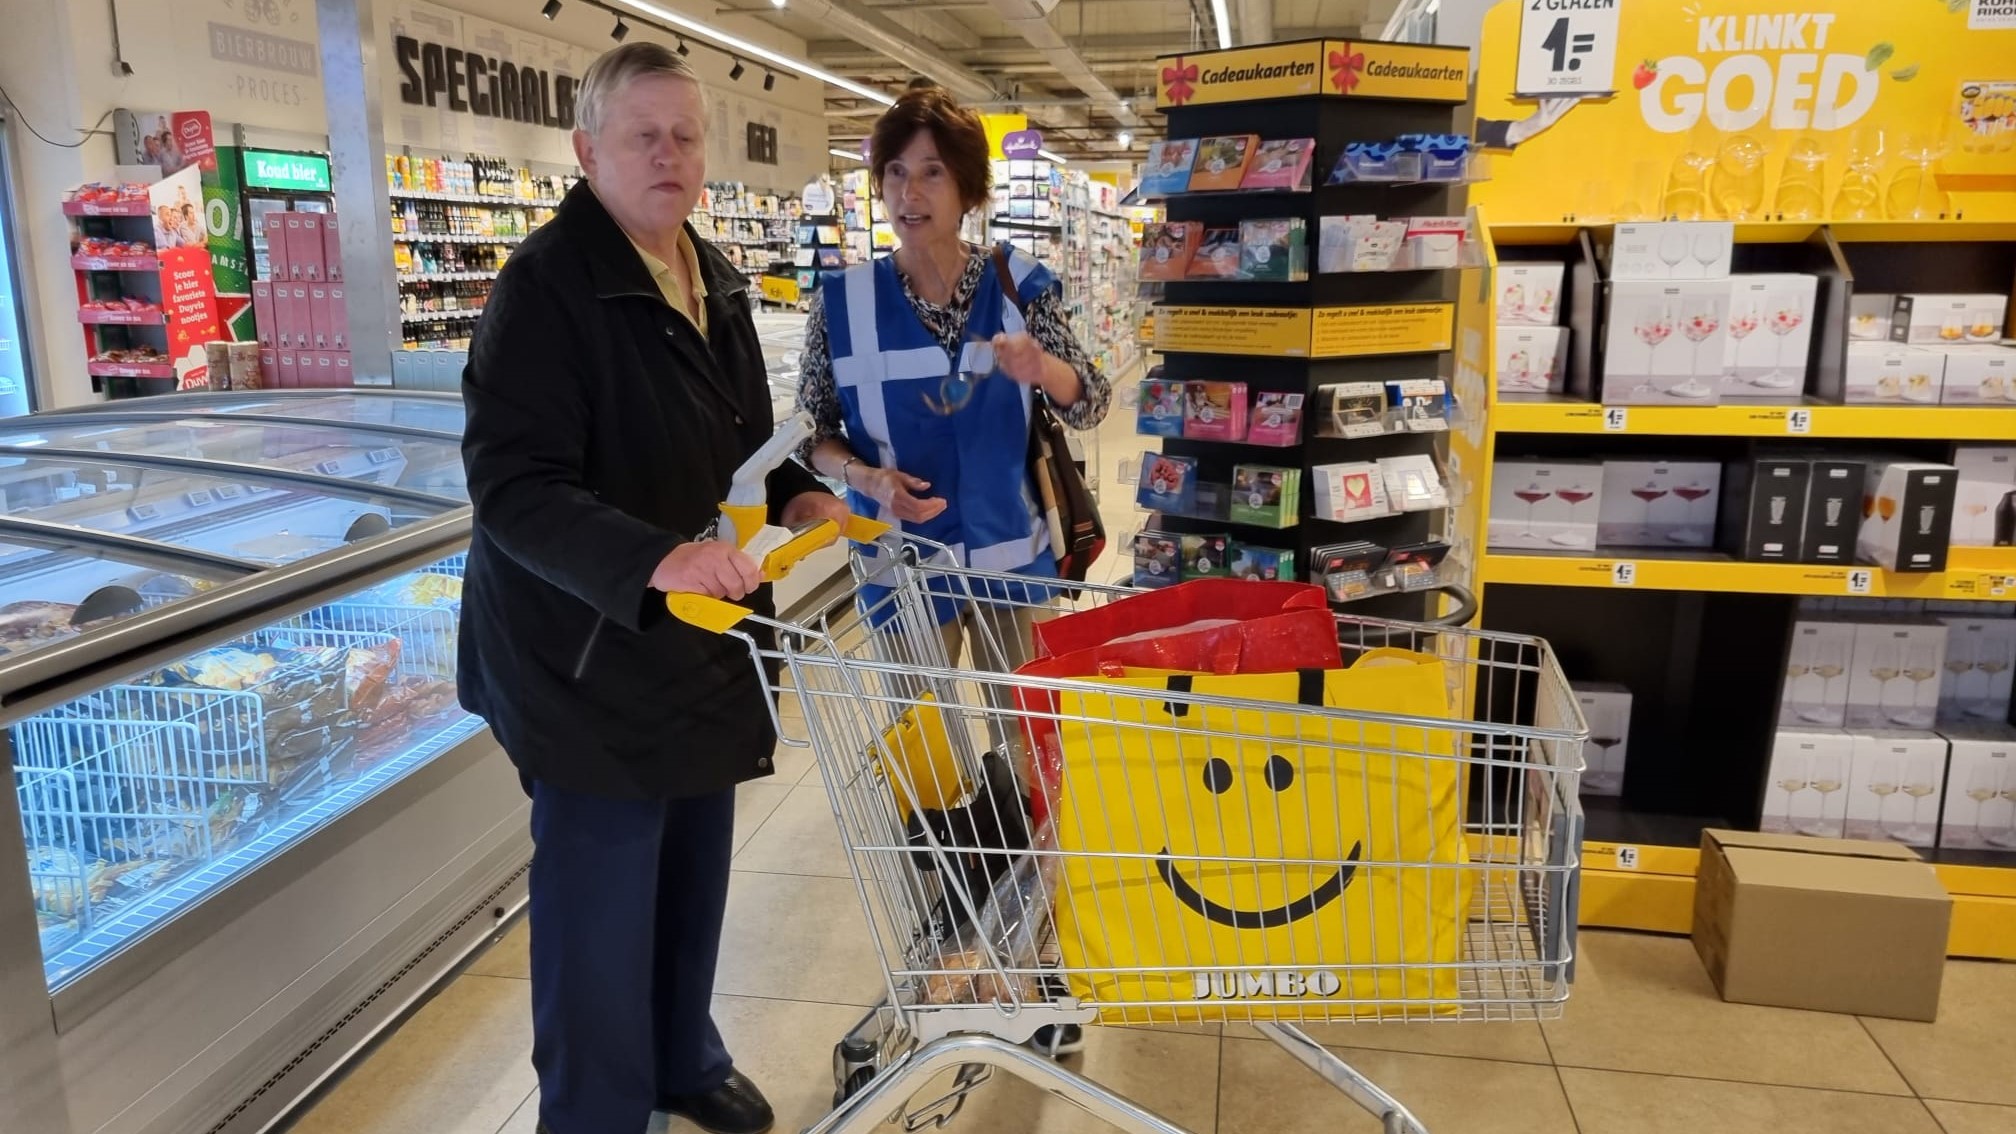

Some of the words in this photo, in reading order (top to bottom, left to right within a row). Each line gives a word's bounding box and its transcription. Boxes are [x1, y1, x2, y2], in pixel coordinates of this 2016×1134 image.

[1977, 7, 2016, 16] RIKO
[1697, 13, 1836, 52] KLINKT
[215, 31, 312, 70] BIERBROUW
[1202, 60, 1315, 85] Cadeaukaarten
[1367, 60, 1464, 81] Cadeaukaarten
[1640, 53, 1880, 133] GOED
[256, 160, 289, 180] Koud
[292, 163, 317, 181] bier
[173, 270, 195, 280] Scoor
[178, 301, 205, 314] Duyvis
[181, 312, 208, 325] nootjes
[1192, 970, 1342, 1000] JUMBO
